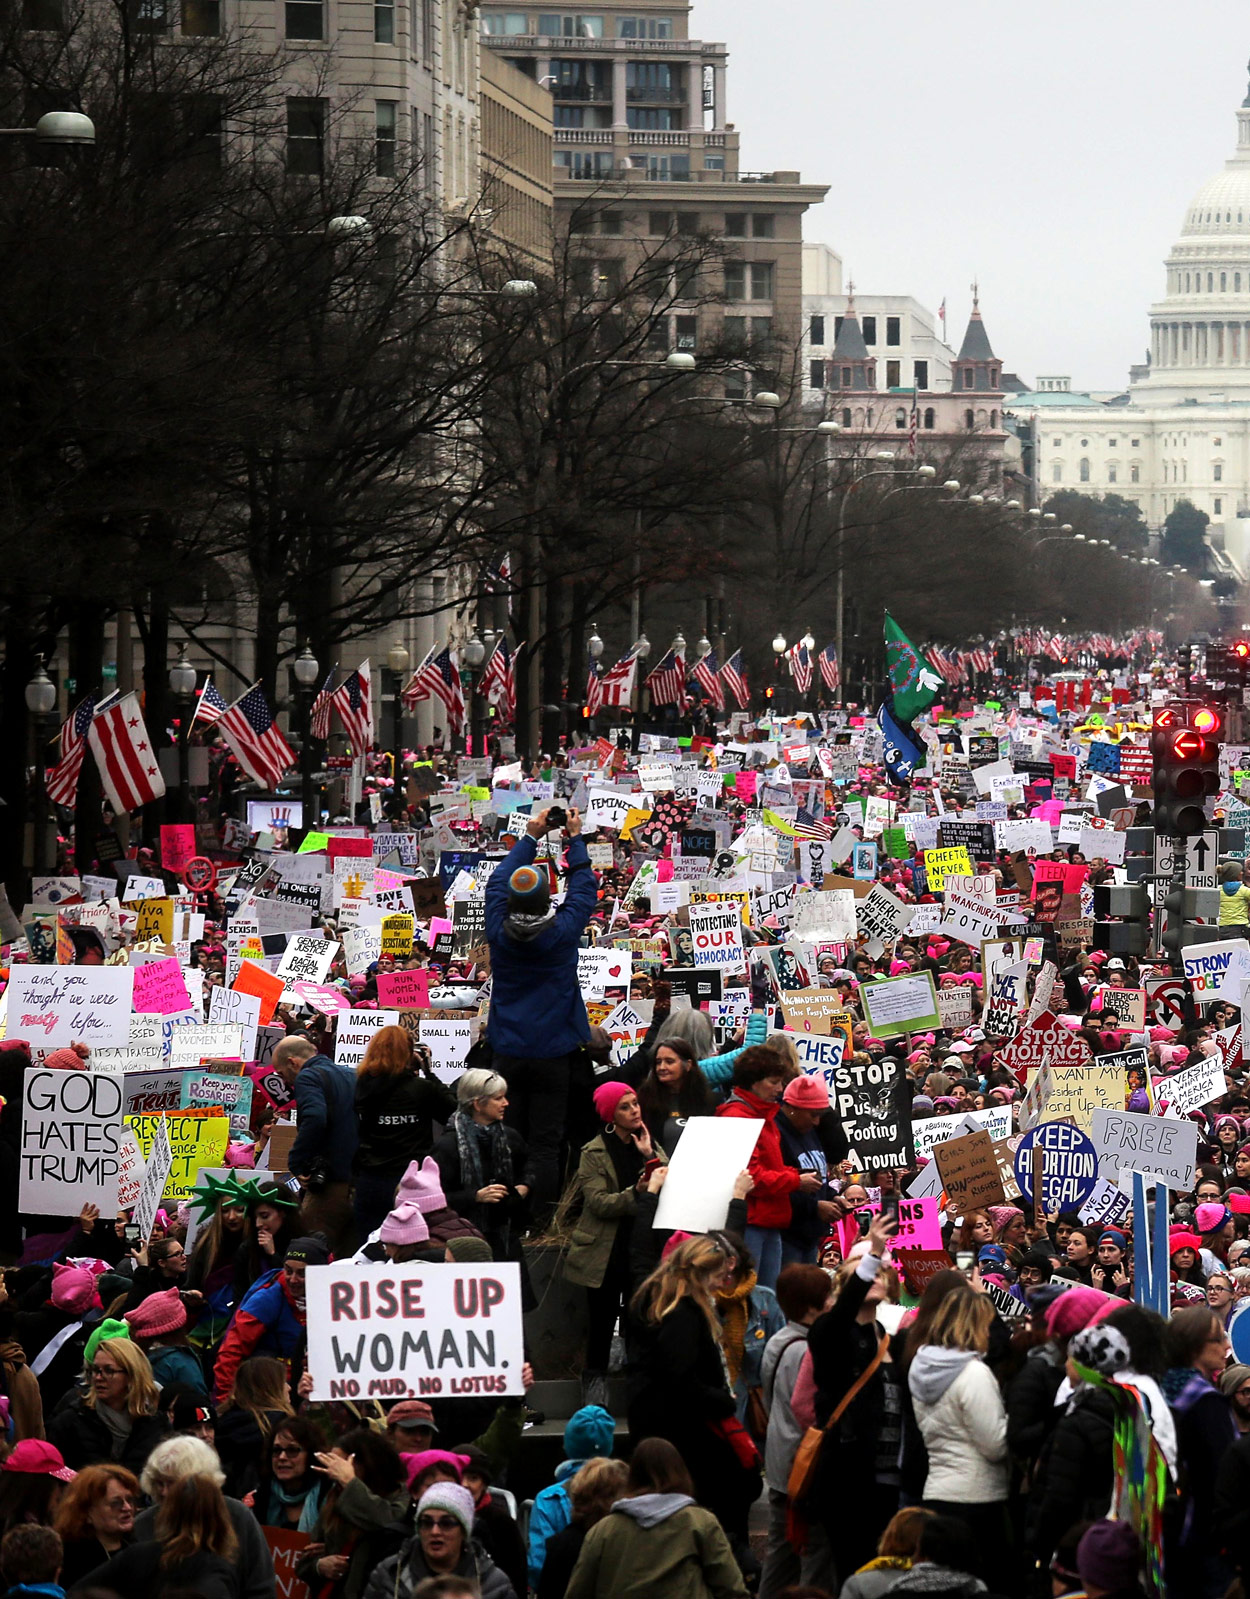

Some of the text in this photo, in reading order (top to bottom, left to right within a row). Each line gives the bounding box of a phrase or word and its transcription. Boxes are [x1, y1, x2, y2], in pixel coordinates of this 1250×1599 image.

[564, 836, 592, 849] NOPE
[928, 849, 967, 863] CHEETOS
[932, 864, 964, 874] NEVER
[1190, 876, 1213, 887] THIS
[696, 932, 736, 948] OUR
[694, 948, 742, 964] DEMOCRACY
[31, 971, 89, 989] and you
[22, 988, 118, 1011] thought we were
[396, 994, 417, 1004] RUN
[19, 1012, 60, 1035] nasty
[349, 1016, 384, 1026] MAKE
[1022, 1031, 1068, 1045] STOP
[1002, 1044, 1094, 1060] VIOLENCE
[836, 1063, 896, 1089] STOP
[26, 1072, 121, 1118] GOD
[23, 1121, 119, 1154] HATES
[841, 1121, 898, 1142] Footing
[1032, 1124, 1078, 1151] KEEP
[1103, 1117, 1177, 1154] FREE
[22, 1154, 119, 1187] TRUMP
[846, 1146, 908, 1174] Around
[1019, 1151, 1094, 1176] AORTION
[330, 1278, 504, 1321] RISE UP
[331, 1330, 509, 1373] WOMAN.
[330, 1376, 507, 1398] NO MUD, NO LOTUS
